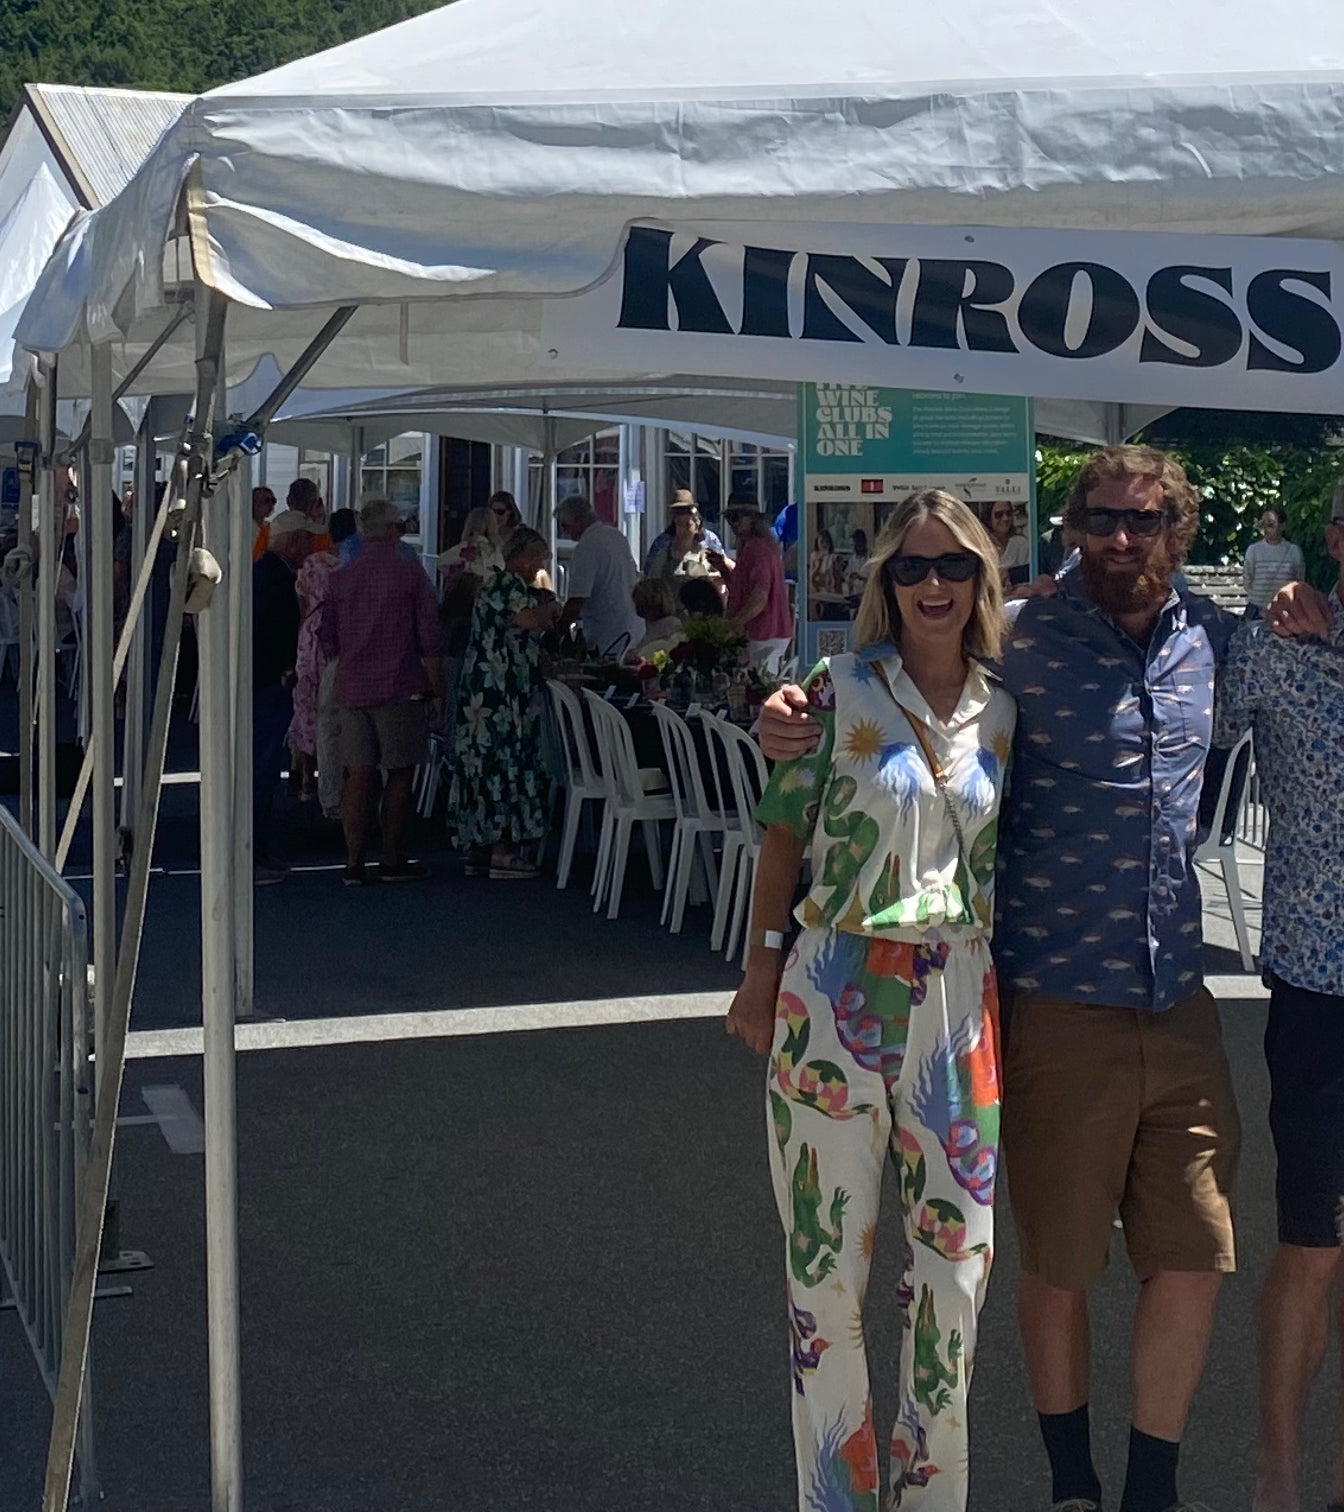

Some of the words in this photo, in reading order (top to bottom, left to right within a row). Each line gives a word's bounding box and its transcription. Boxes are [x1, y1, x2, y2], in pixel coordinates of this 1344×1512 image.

[617, 227, 1342, 374] KINROSS
[816, 390, 879, 406] WINE
[816, 407, 893, 423] CLUBS
[817, 423, 863, 439] ALL
[865, 423, 890, 439] IN
[816, 439, 863, 456] ONE
